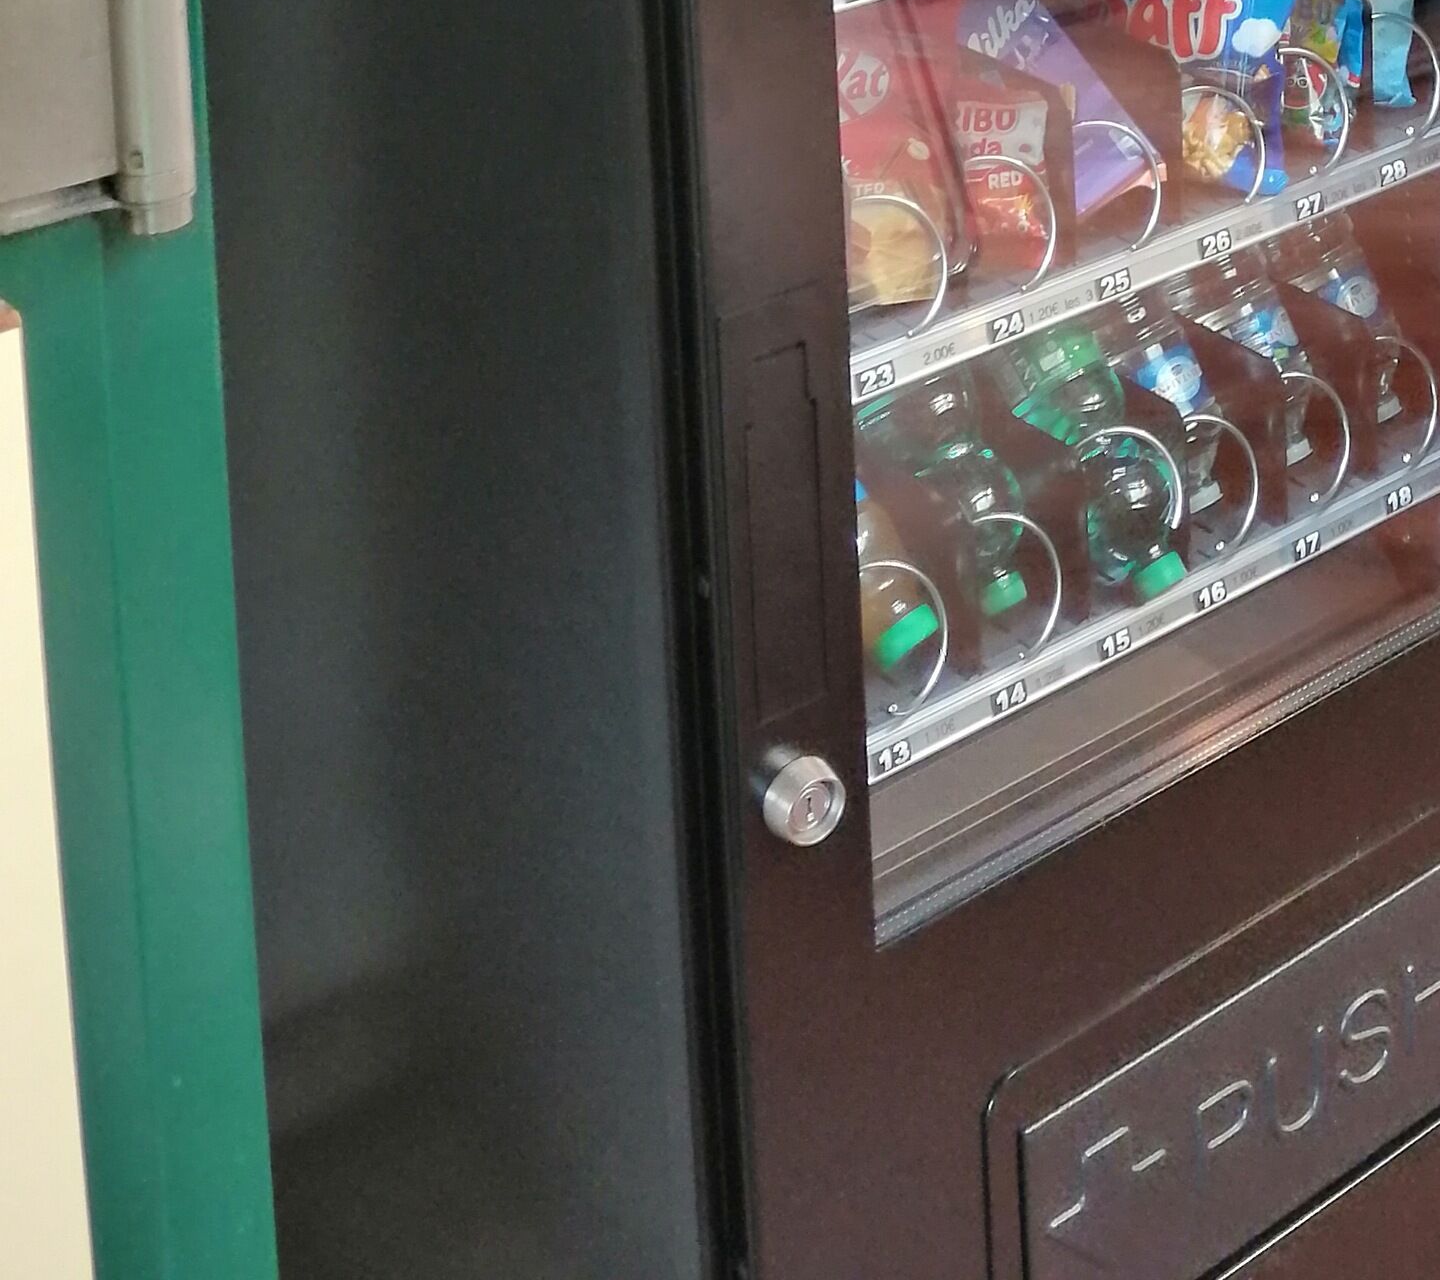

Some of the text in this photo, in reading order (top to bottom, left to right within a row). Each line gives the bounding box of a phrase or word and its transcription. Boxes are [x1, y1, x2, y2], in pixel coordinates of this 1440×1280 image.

[1380, 159, 1408, 188] 28
[1296, 192, 1323, 220] 27
[1201, 230, 1232, 259] 26
[1099, 269, 1131, 300] 25
[992, 311, 1024, 342] 24
[1028, 302, 1059, 325] 1.20€
[858, 342, 956, 395] 23 2.00€
[1386, 485, 1413, 512] 18
[1295, 530, 1321, 559] 17
[1198, 580, 1227, 610] 16
[1102, 627, 1131, 659] 15
[995, 680, 1027, 713] 14
[878, 740, 912, 773] 13
